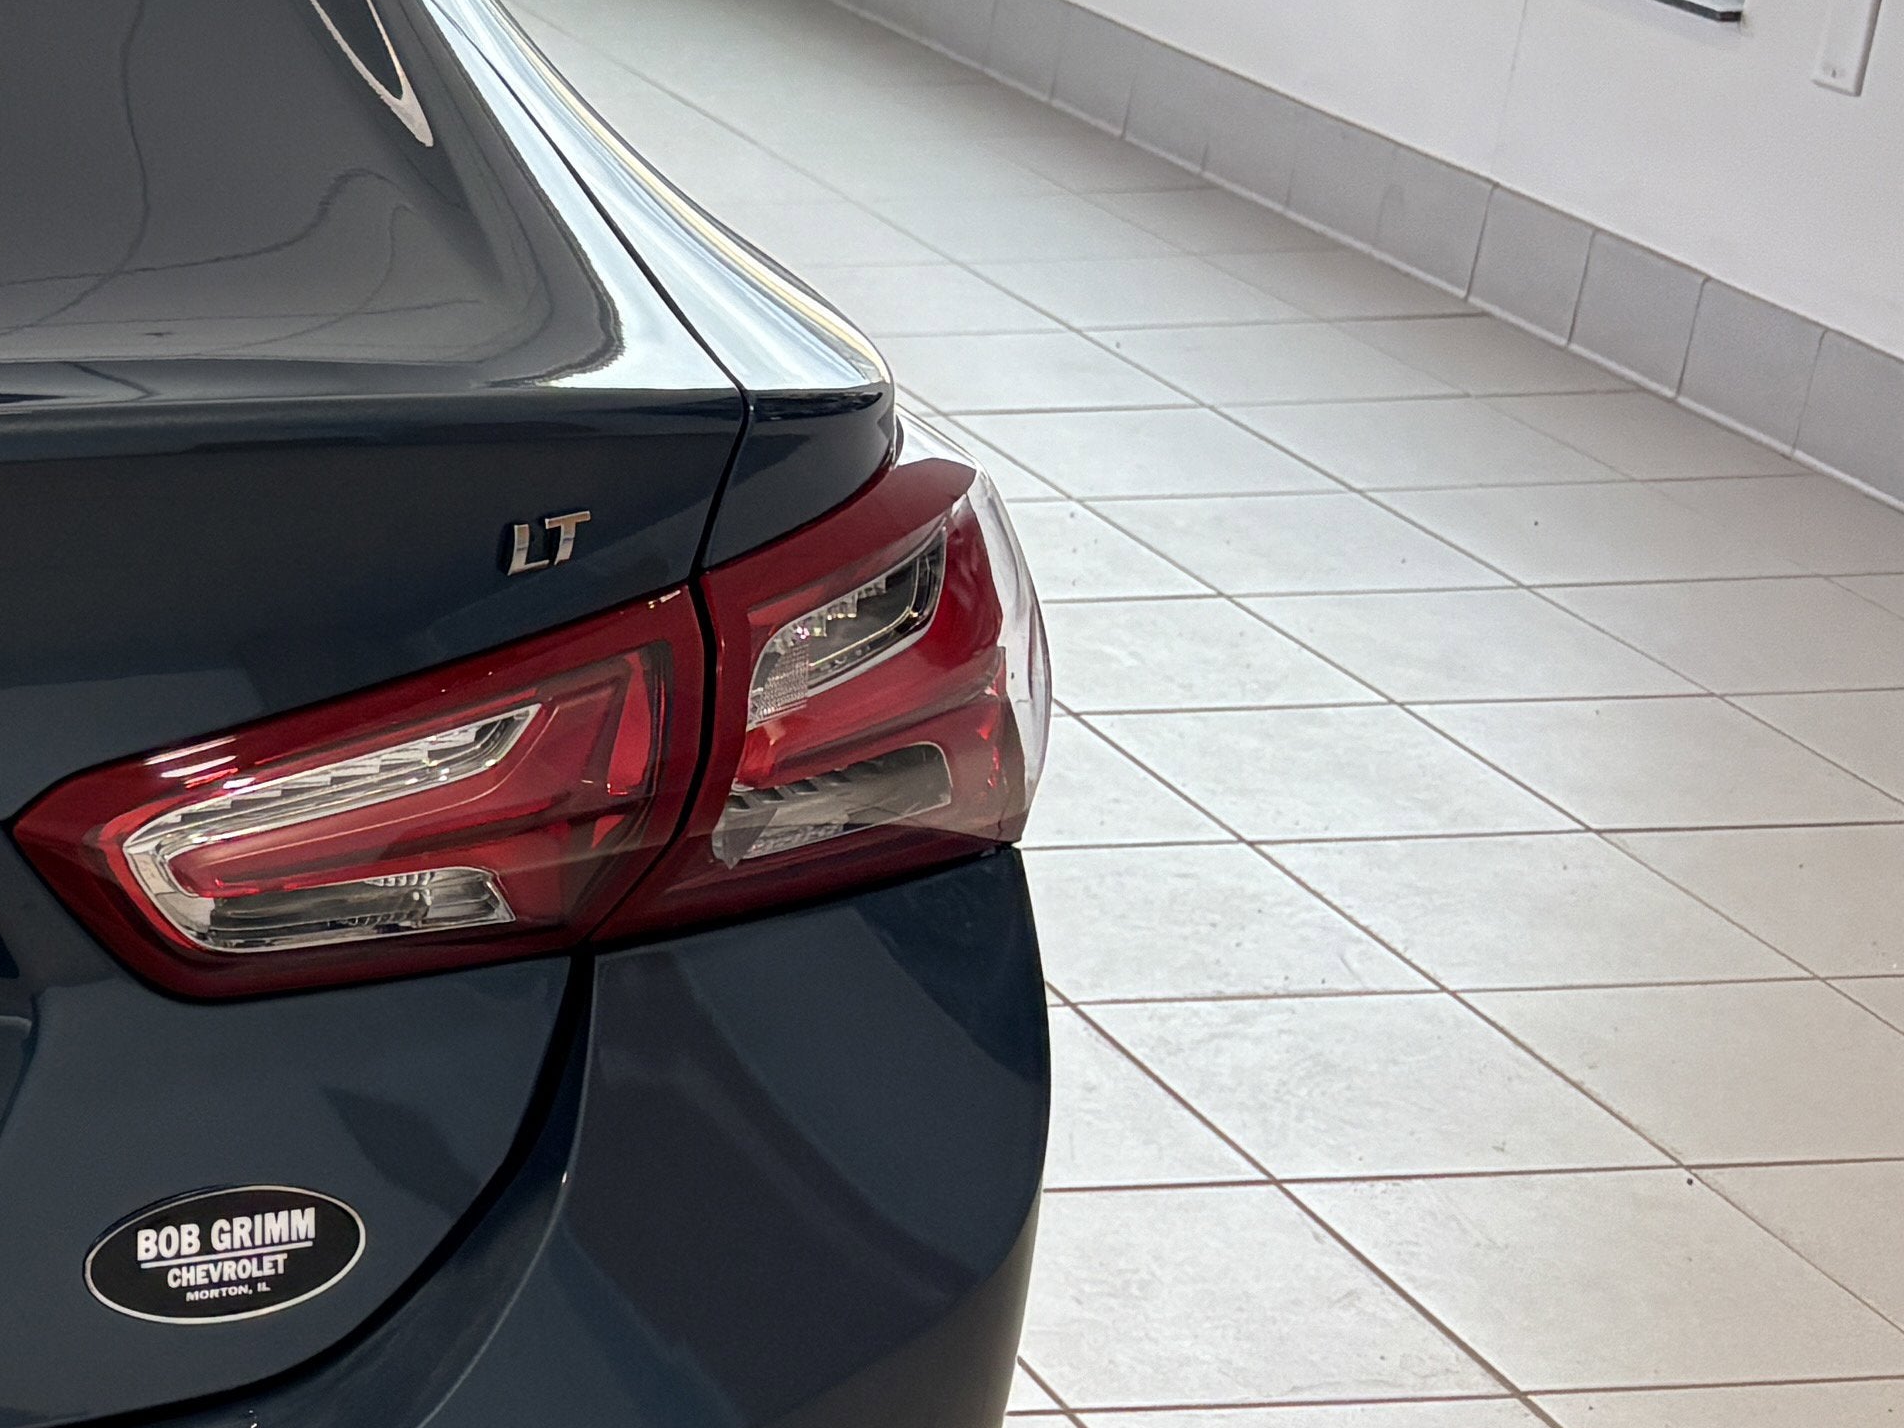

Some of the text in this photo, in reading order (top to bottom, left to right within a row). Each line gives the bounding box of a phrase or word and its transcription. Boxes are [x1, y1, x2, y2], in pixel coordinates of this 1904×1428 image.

[507, 510, 591, 576] LT
[137, 1207, 316, 1260] BOB GRIMM
[167, 1253, 288, 1288] CHEVROLET
[185, 1282, 271, 1302] MORTON, IL
